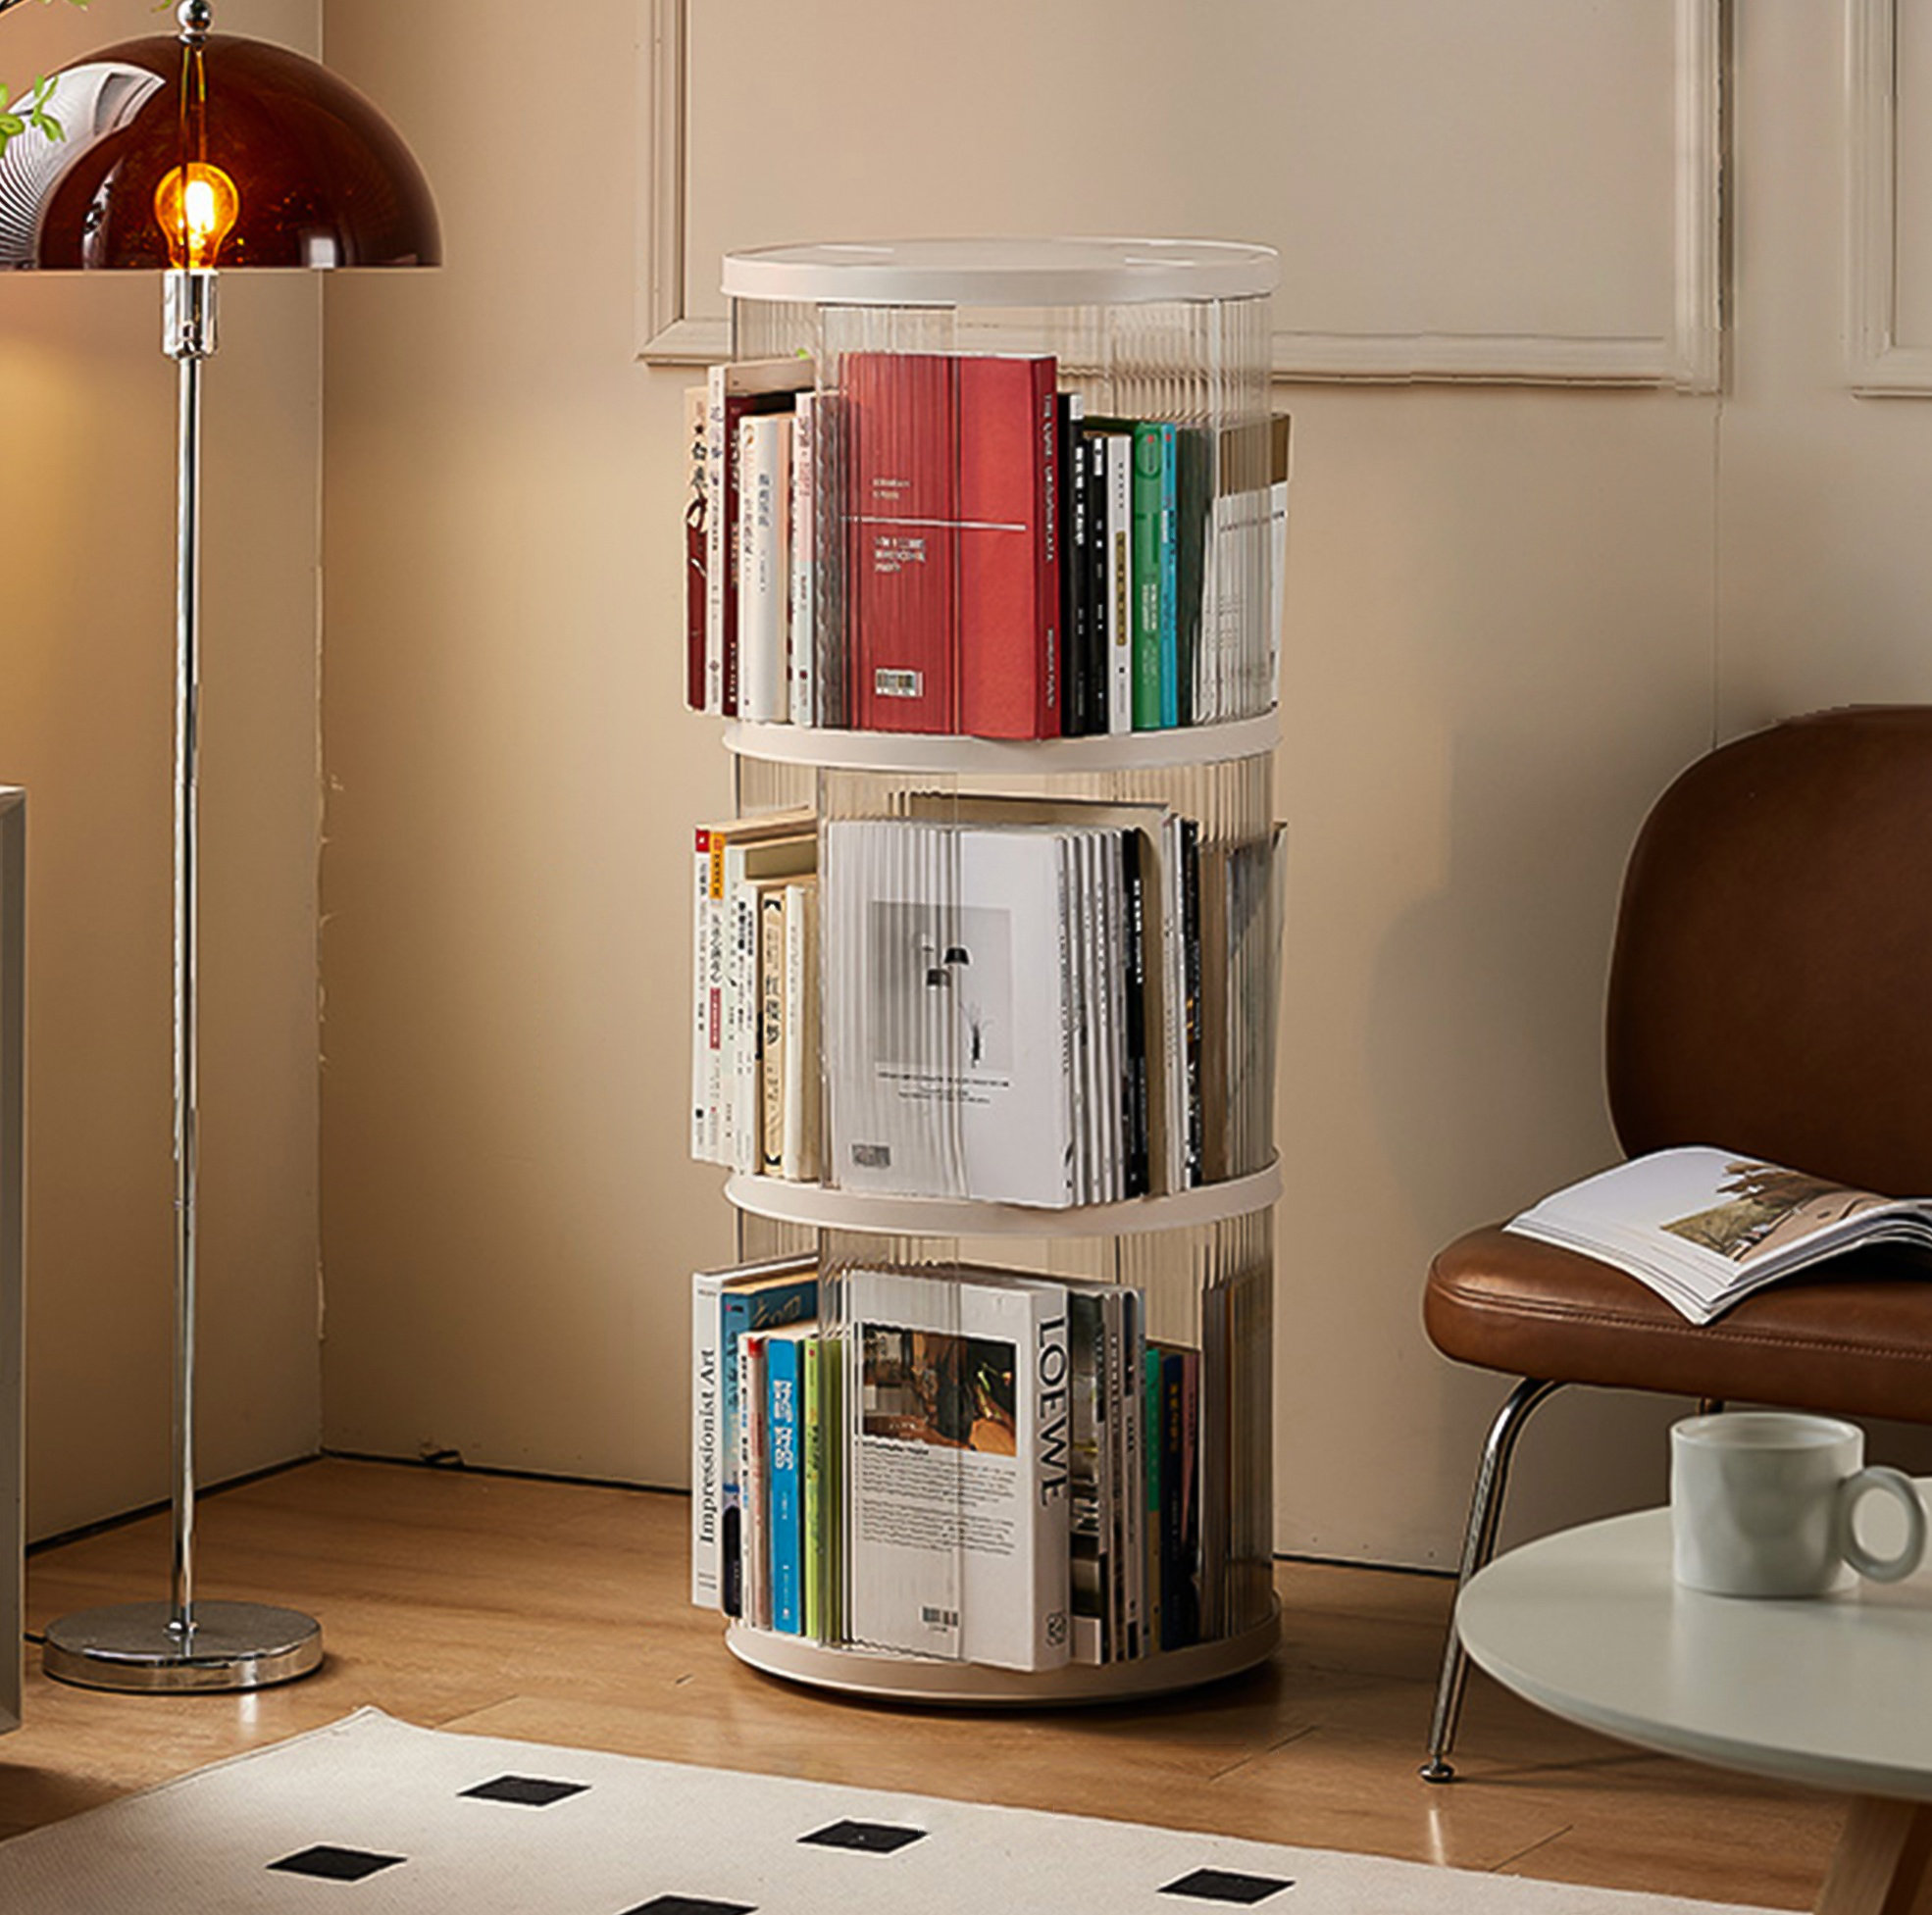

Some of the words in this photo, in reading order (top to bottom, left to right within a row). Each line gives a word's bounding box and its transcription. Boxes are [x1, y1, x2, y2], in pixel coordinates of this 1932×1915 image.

[700, 1349, 715, 1386] Art
[1039, 1316, 1068, 1507] LOEWE
[699, 1391, 718, 1544] Impressionist
